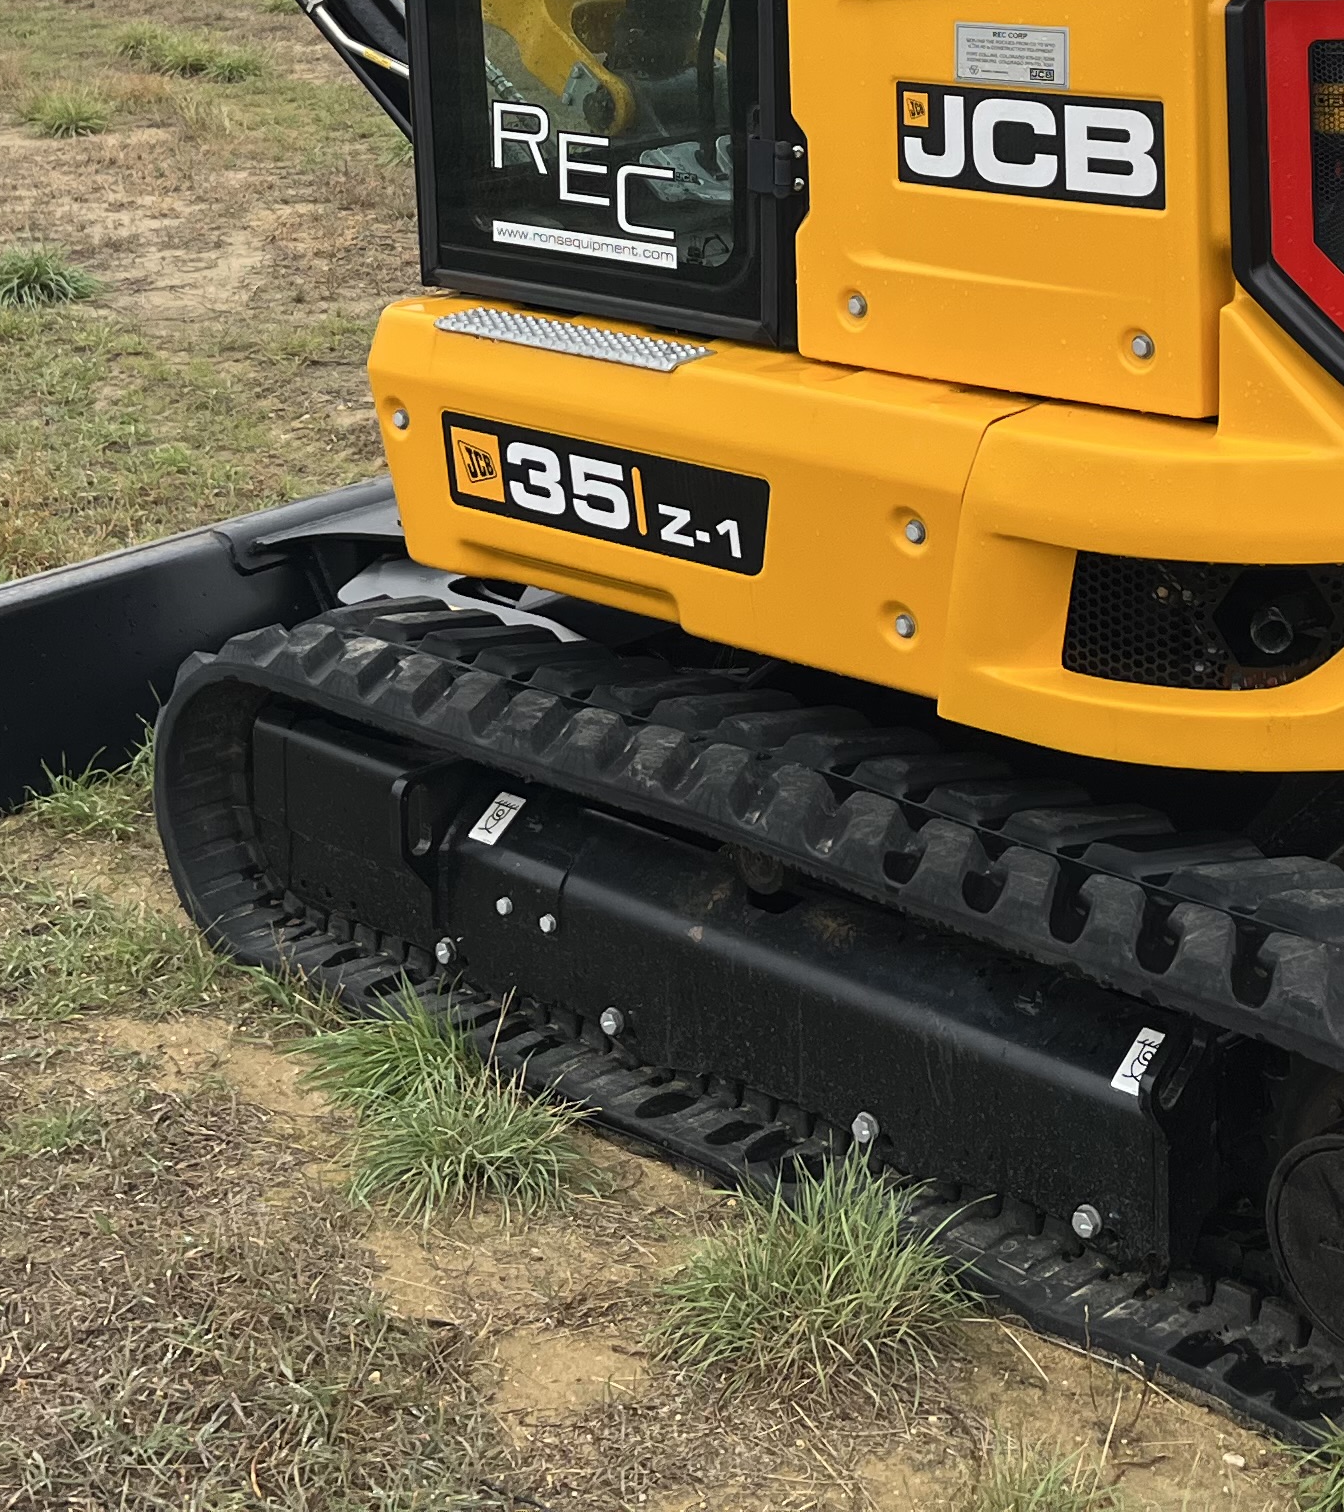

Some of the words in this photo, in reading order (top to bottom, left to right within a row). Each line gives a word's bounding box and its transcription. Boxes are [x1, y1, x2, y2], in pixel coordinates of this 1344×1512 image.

[493, 102, 675, 240] REC
[904, 95, 1158, 197] JCB
[496, 226, 674, 263] www.ronsequipment.com
[466, 445, 494, 479] JCB
[658, 503, 741, 558] Z-1
